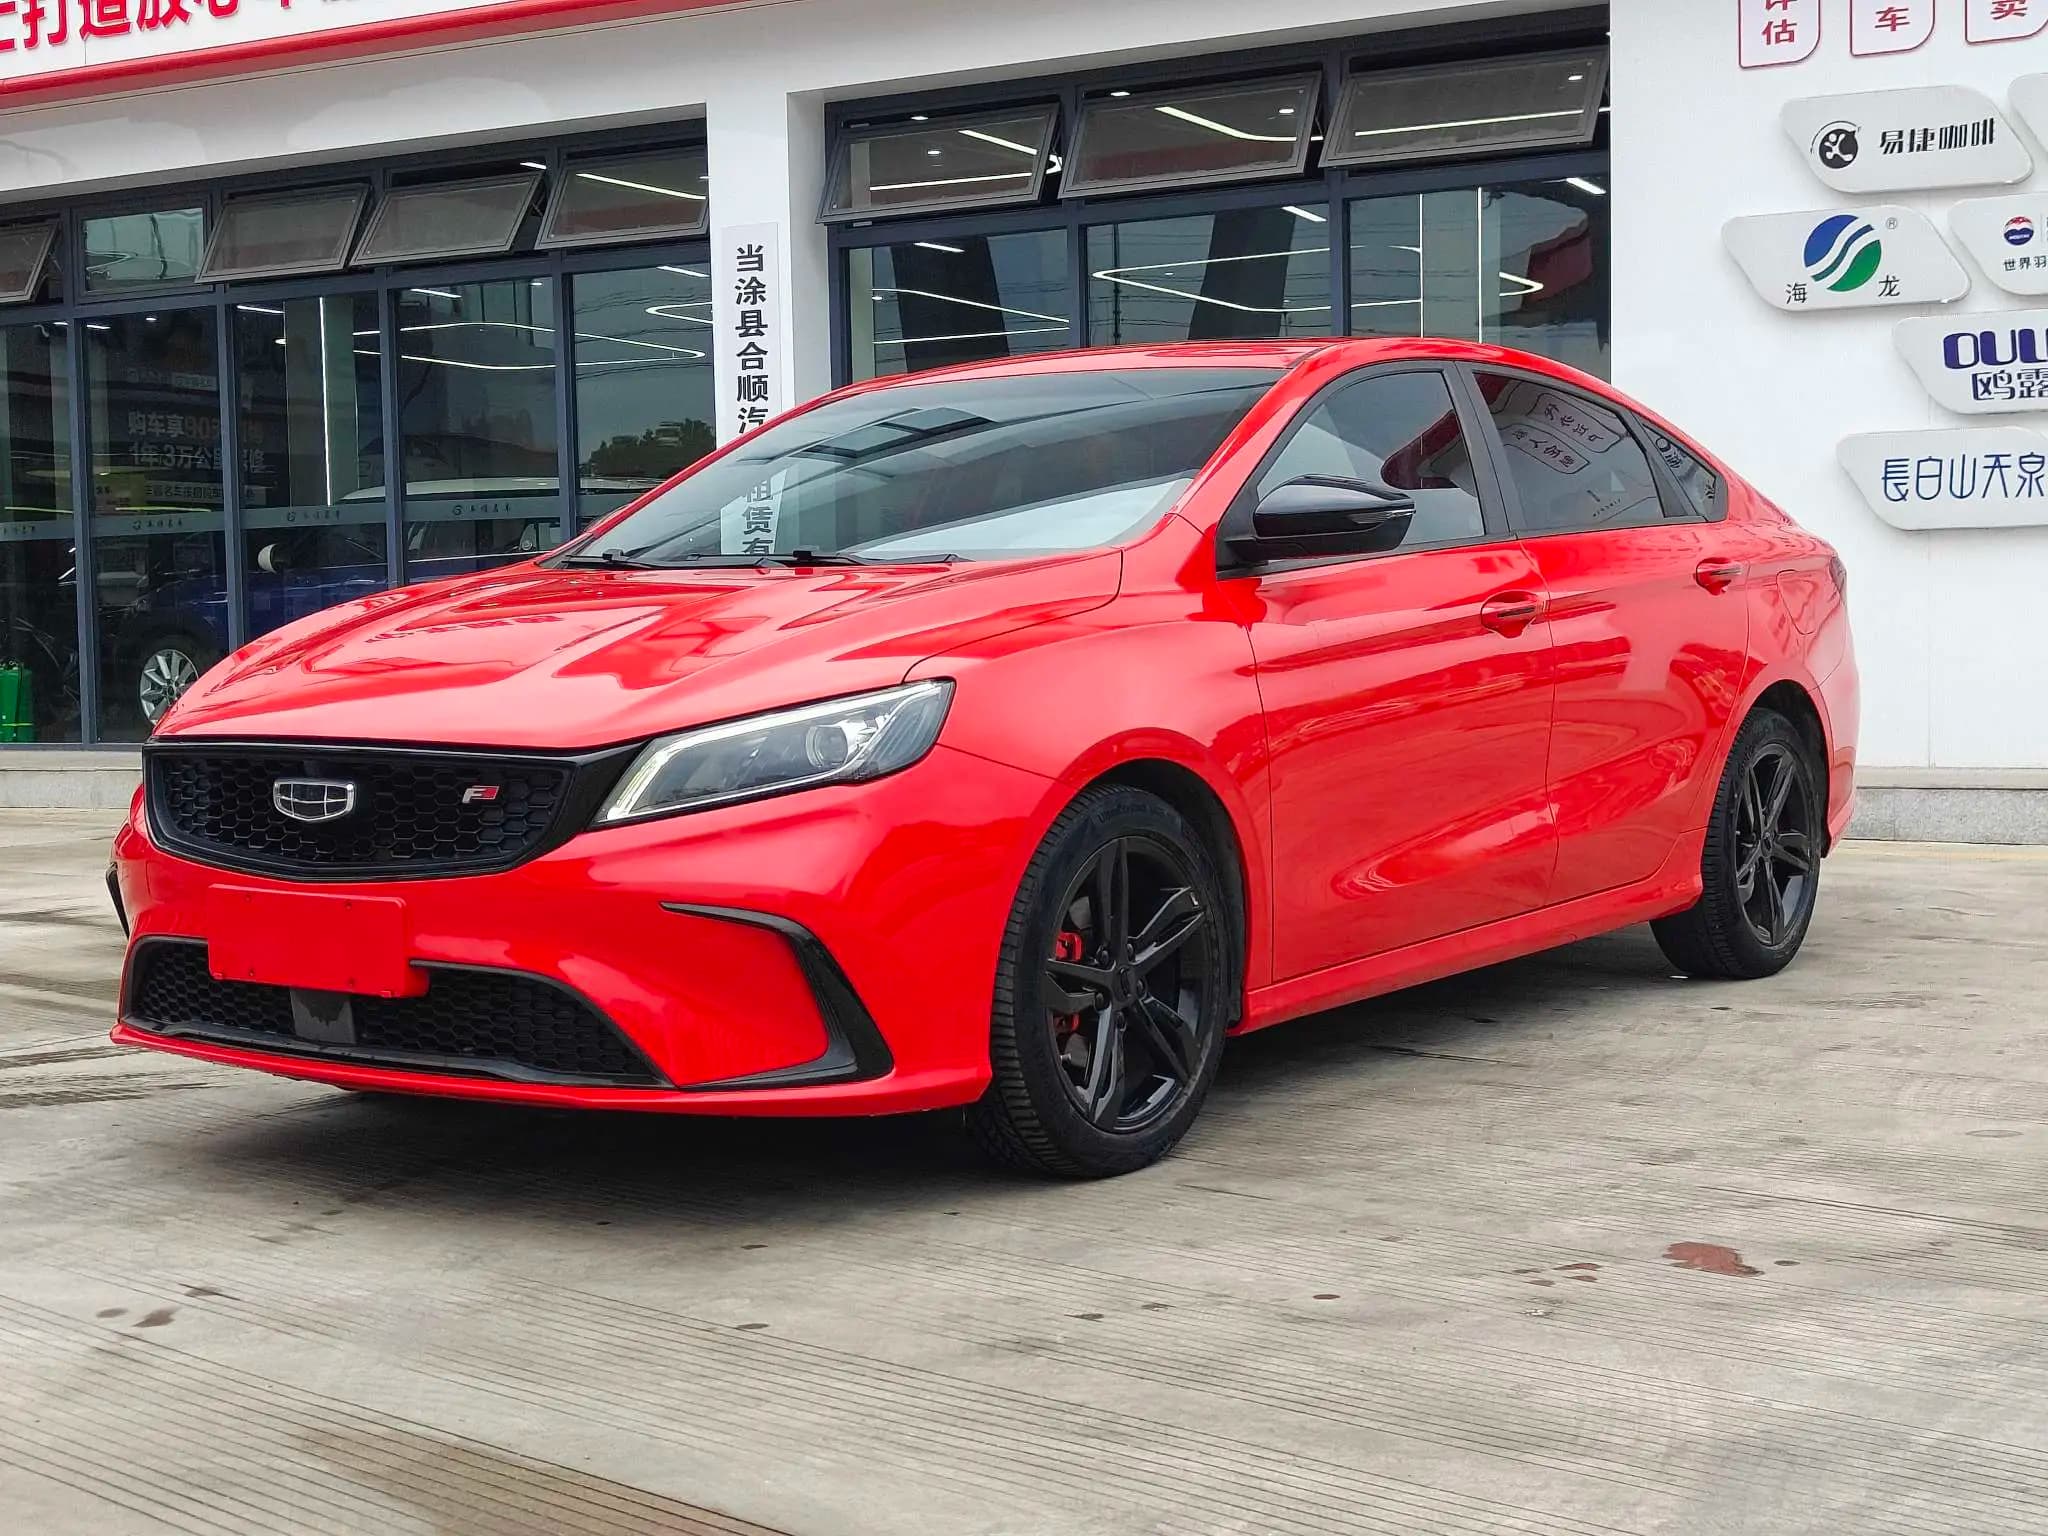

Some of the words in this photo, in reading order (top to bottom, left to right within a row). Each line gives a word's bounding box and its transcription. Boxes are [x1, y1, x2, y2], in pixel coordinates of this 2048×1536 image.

[1878, 117, 1994, 154] 易捷咖啡
[1786, 283, 1808, 304] 海
[1878, 275, 1901, 297] 龙
[1942, 328, 2048, 369] OUL
